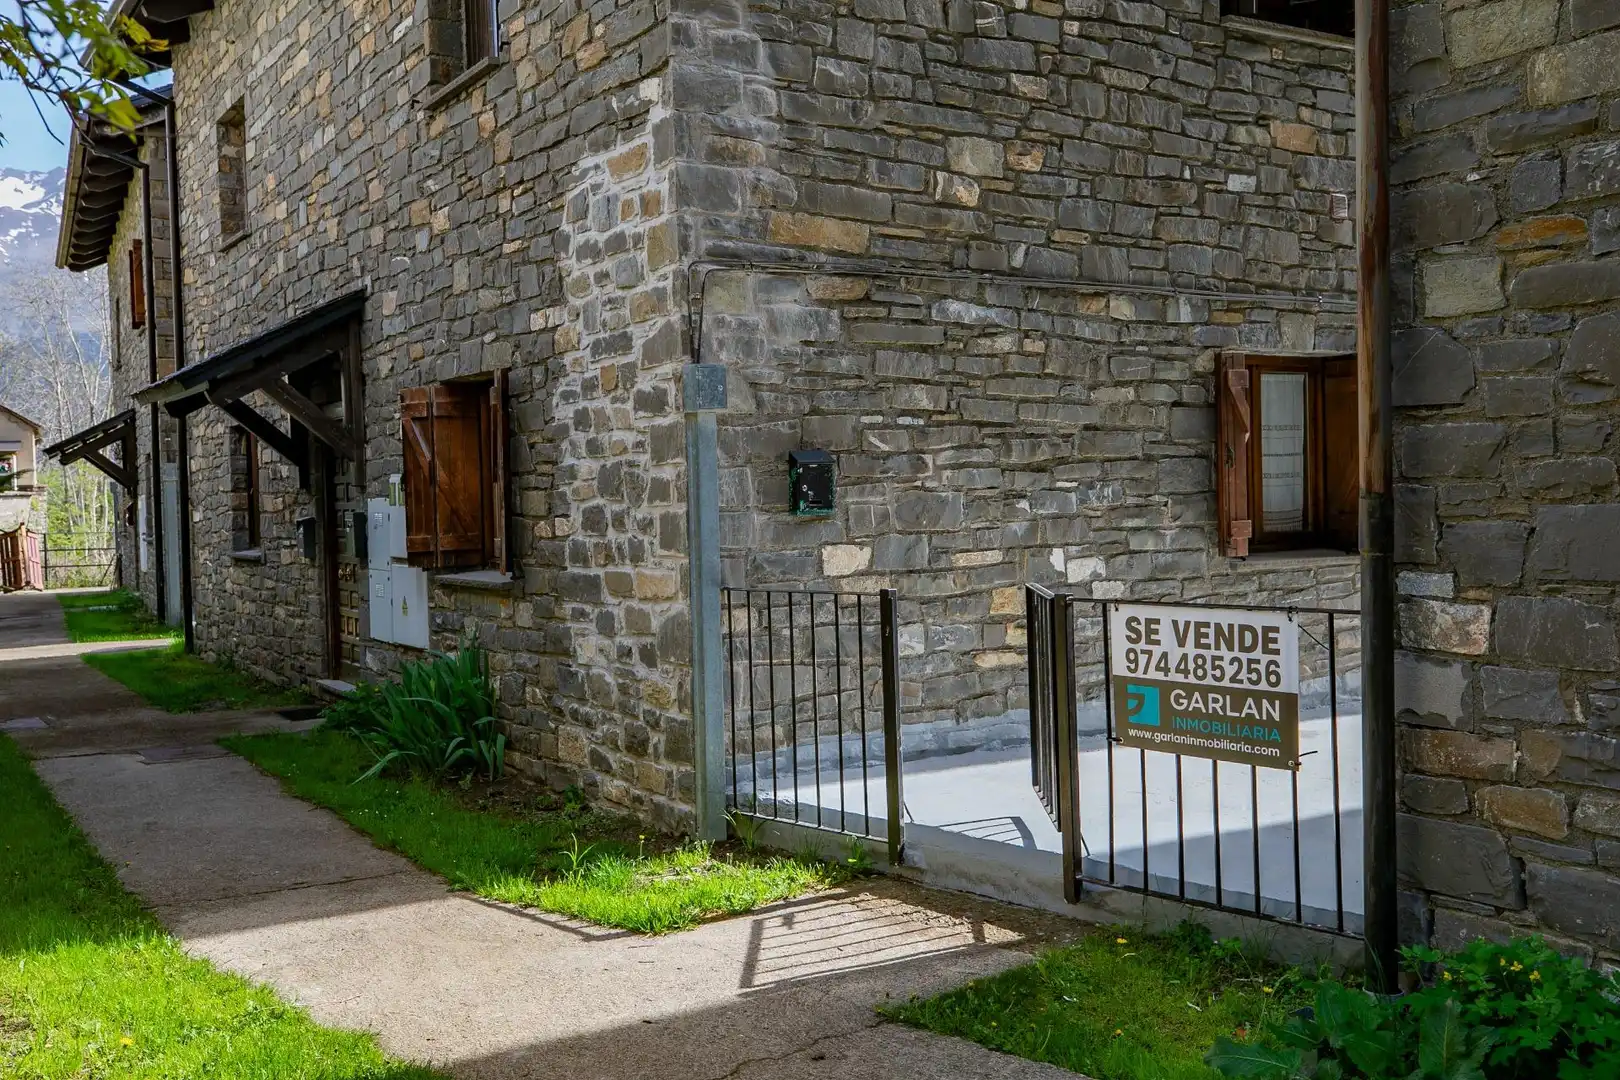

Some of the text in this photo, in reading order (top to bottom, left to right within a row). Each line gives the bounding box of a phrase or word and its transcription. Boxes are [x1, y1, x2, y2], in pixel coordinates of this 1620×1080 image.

[1125, 616, 1281, 655] SE VENDE
[1125, 648, 1281, 688] 974485256
[1170, 689, 1280, 721] GARLAN
[1128, 728, 1280, 757] www.garlaninmobiliaria.com
[1172, 716, 1281, 742] INMOBILIARIA
